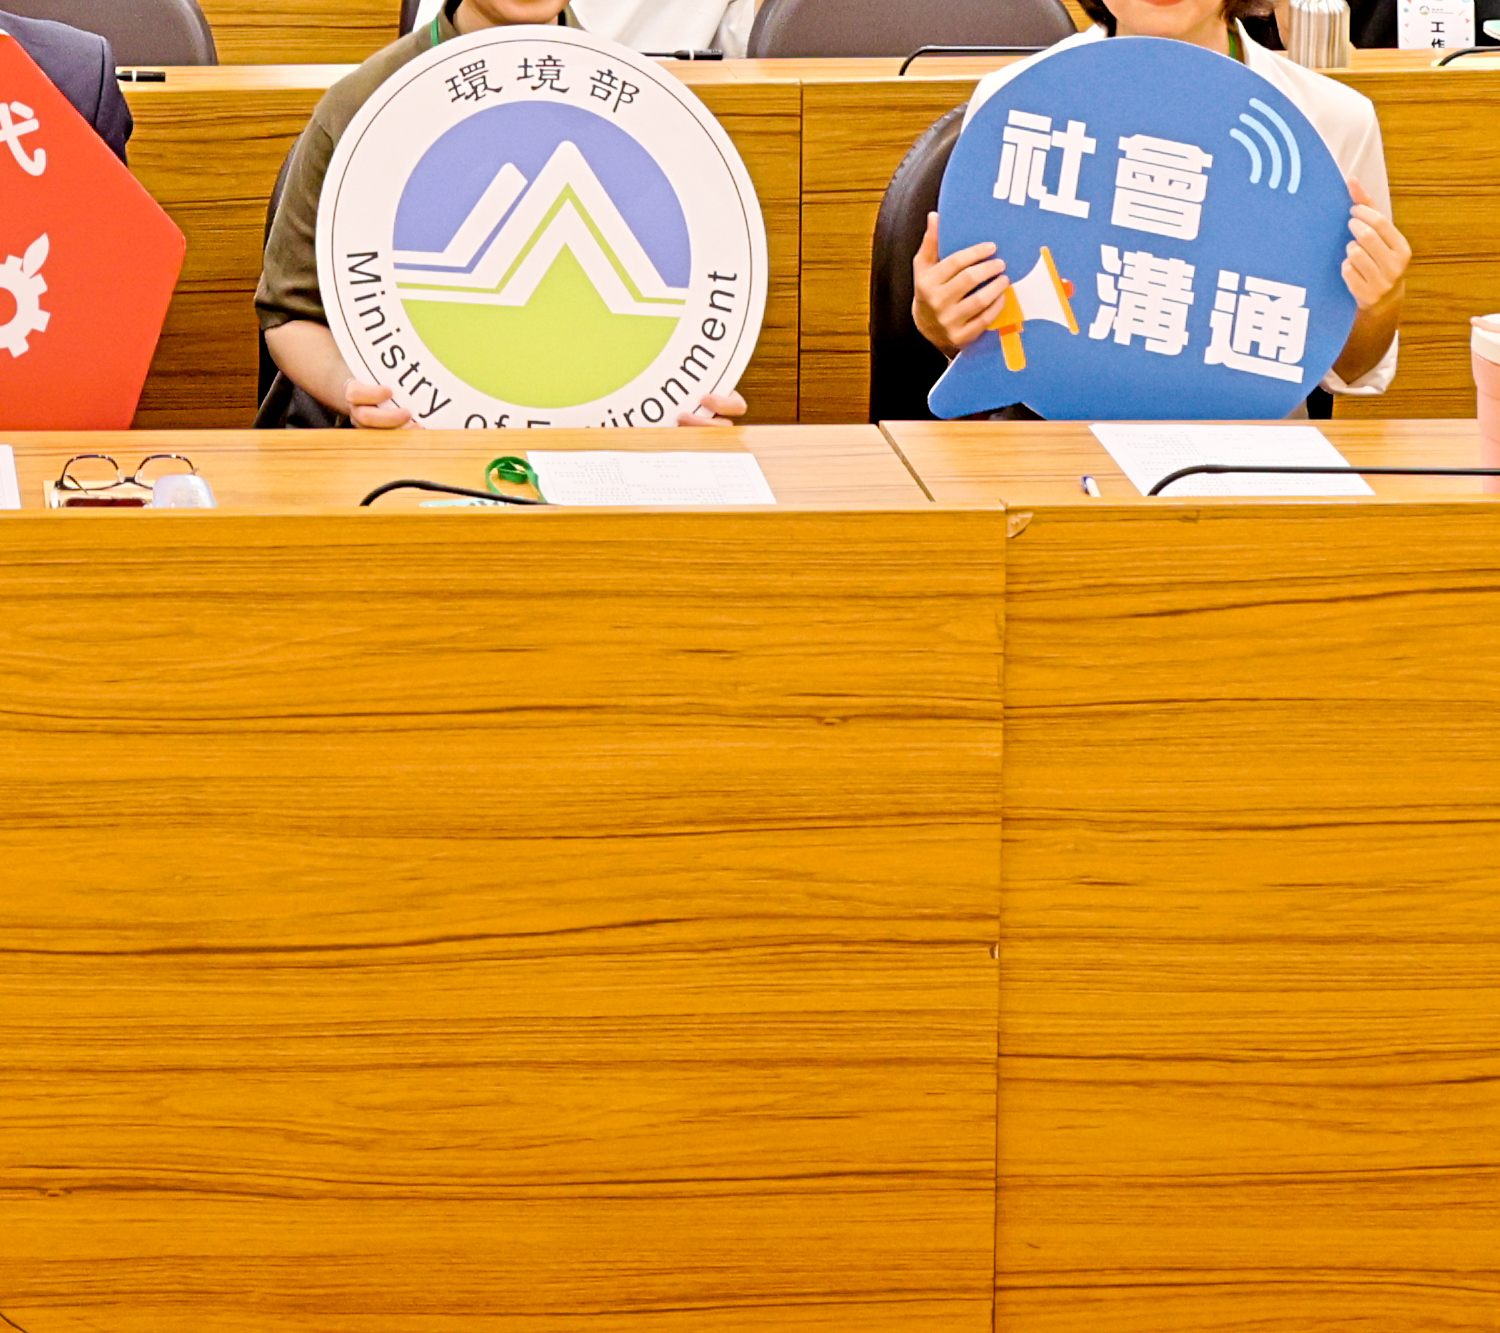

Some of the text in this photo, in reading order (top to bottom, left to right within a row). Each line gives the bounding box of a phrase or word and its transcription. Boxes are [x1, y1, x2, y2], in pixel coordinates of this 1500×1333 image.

[446, 52, 641, 115] 環境部
[991, 106, 1215, 242] 社會
[346, 250, 453, 420] Ministry
[1088, 243, 1310, 385] 溝通
